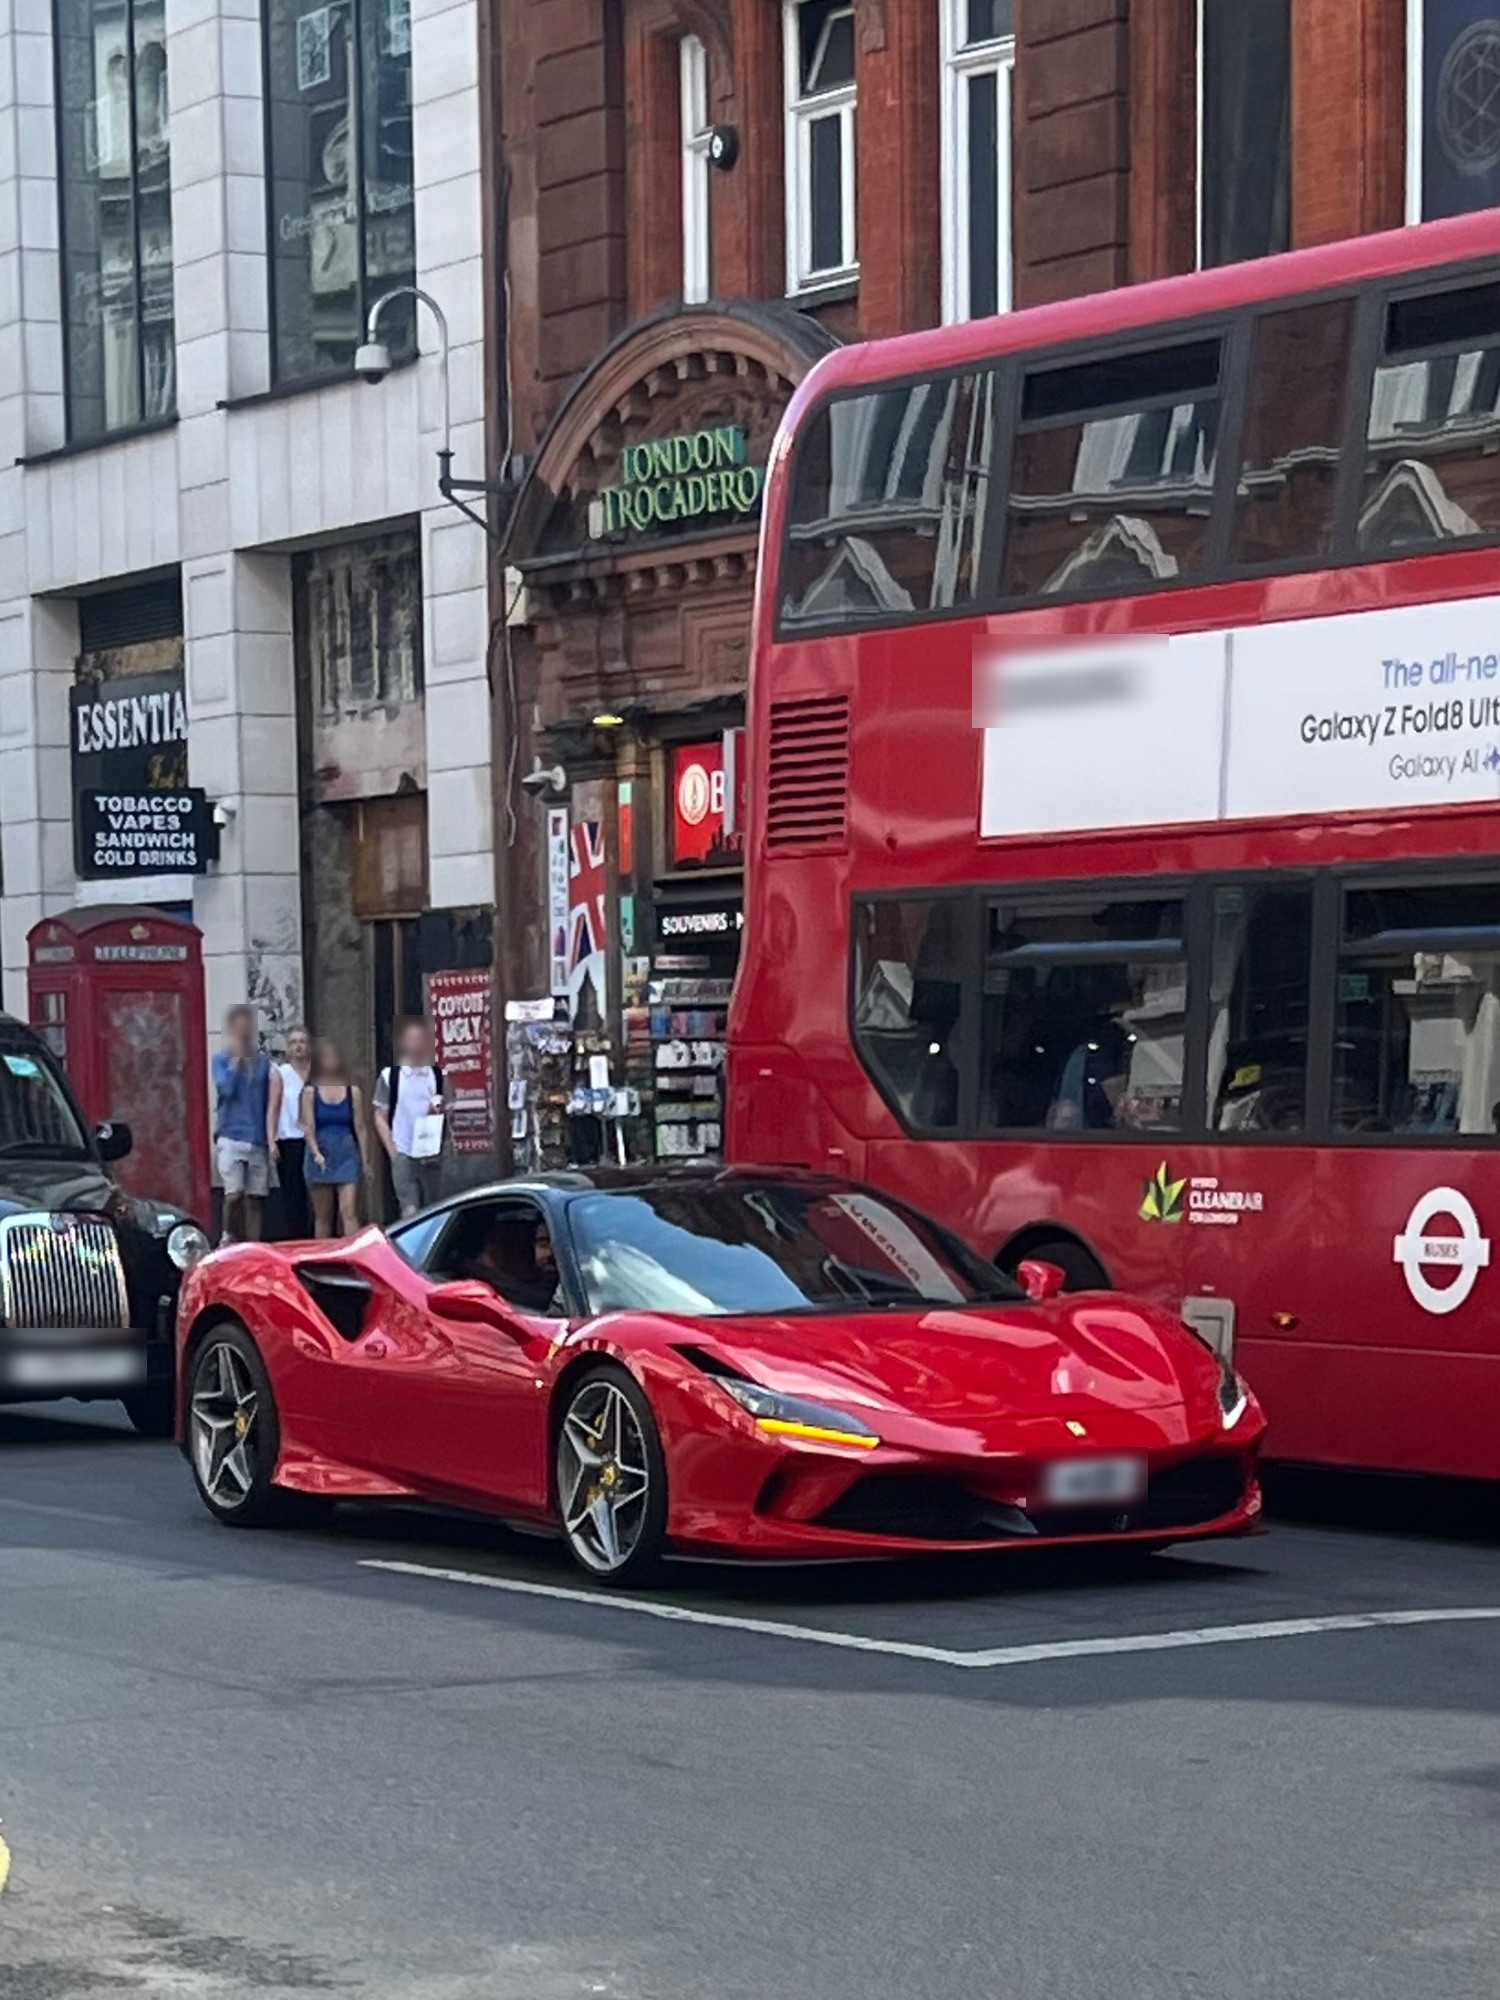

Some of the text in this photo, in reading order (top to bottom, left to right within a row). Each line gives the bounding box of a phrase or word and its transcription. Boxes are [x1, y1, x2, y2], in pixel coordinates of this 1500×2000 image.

[623, 425, 738, 484] LONDON
[602, 466, 759, 532] TROCADERO
[1381, 652, 1500, 689] The all-ne
[78, 691, 189, 753] ESSENTIA
[1300, 711, 1381, 746] Galaxy
[1383, 706, 1397, 736] Z
[1401, 700, 1463, 735] Fold8
[1388, 748, 1479, 784] Galaxy AI
[95, 796, 193, 813] TOBACCO
[108, 814, 181, 830] VAPES
[94, 850, 198, 866] COLD DRINKS
[95, 832, 195, 848] SANDWICH
[661, 911, 729, 936] SOUVENIRS
